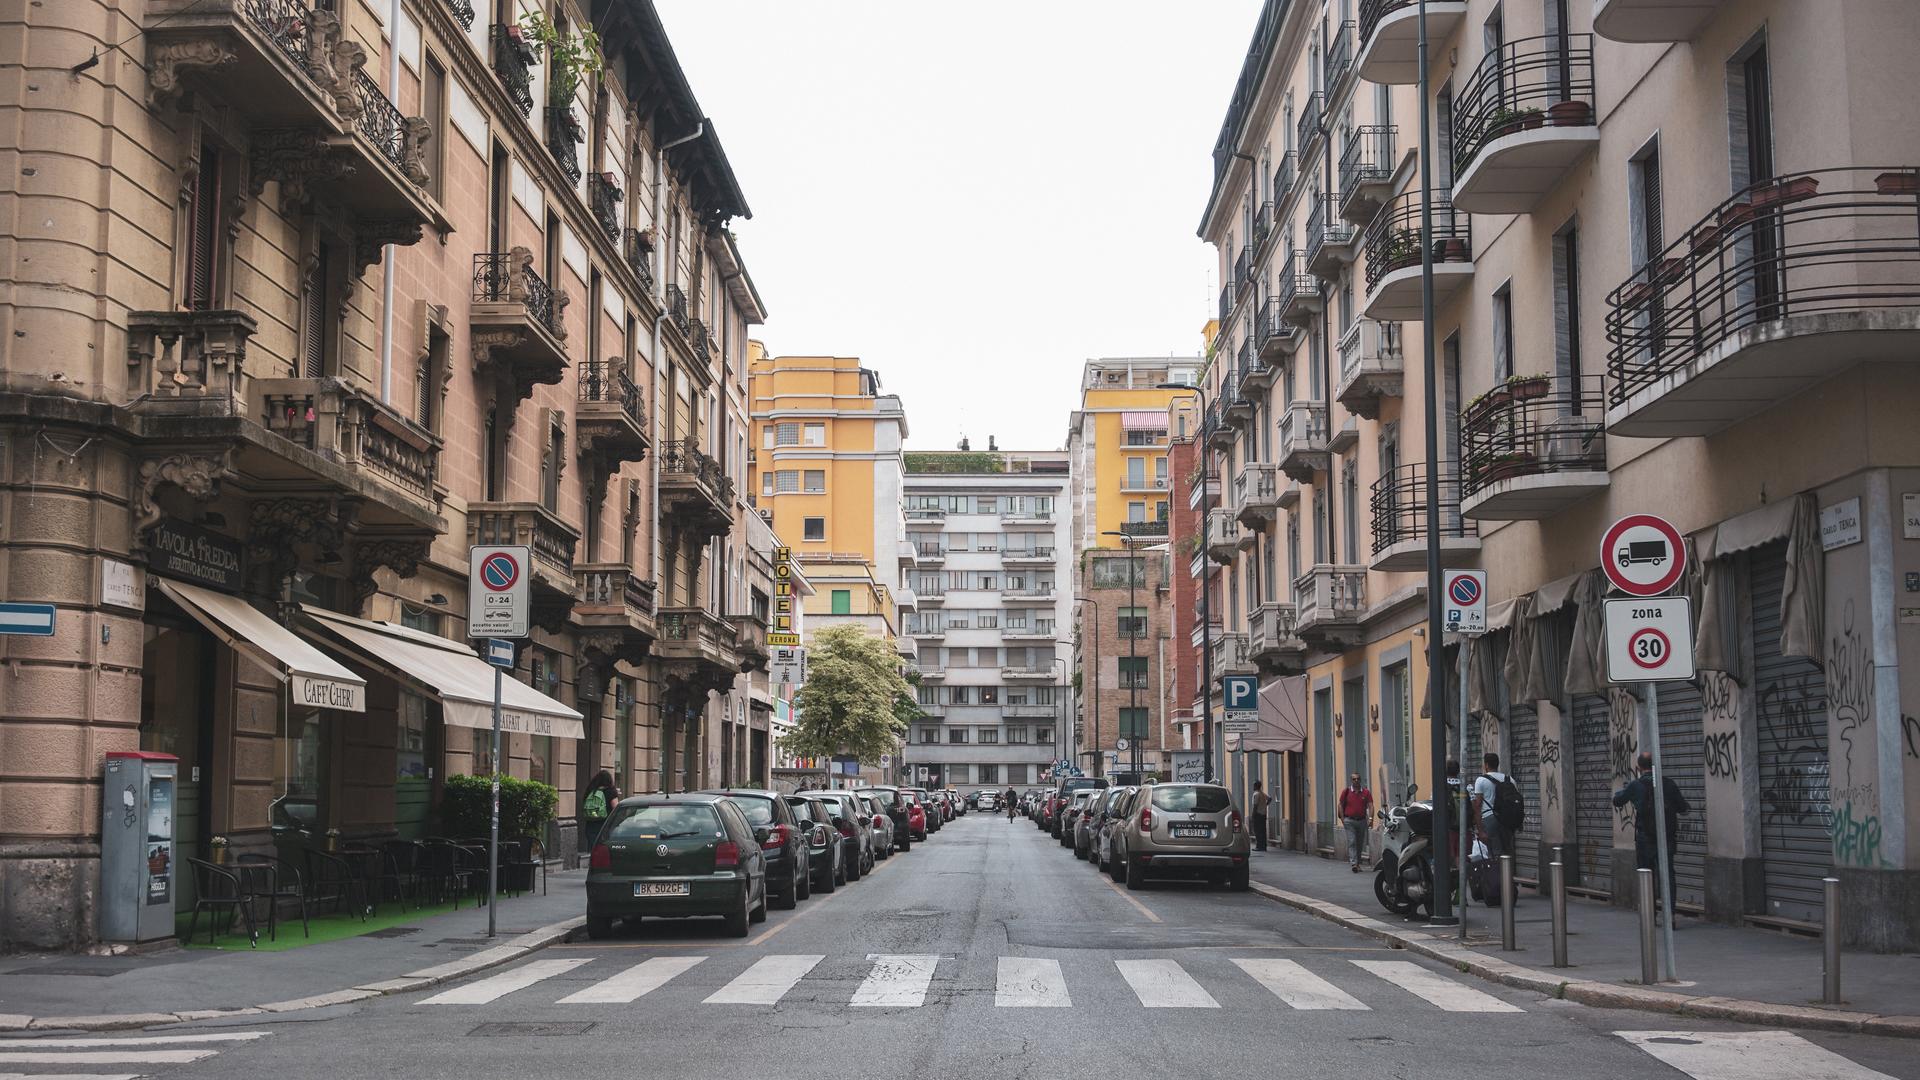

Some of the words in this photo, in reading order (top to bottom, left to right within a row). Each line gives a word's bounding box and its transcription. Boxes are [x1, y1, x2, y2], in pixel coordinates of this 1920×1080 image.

[1823, 525, 1837, 536] CARLO
[1838, 517, 1857, 531] TENCA
[197, 535, 240, 573] FREDDA
[122, 584, 143, 598] TENCA
[777, 549, 789, 629] HOTEL
[1632, 608, 1662, 619] zona
[1638, 639, 1661, 658] 30
[330, 682, 354, 708] CHERI
[1232, 680, 1250, 706] P
[534, 715, 551, 734] LUNCH
[640, 884, 652, 894] BK
